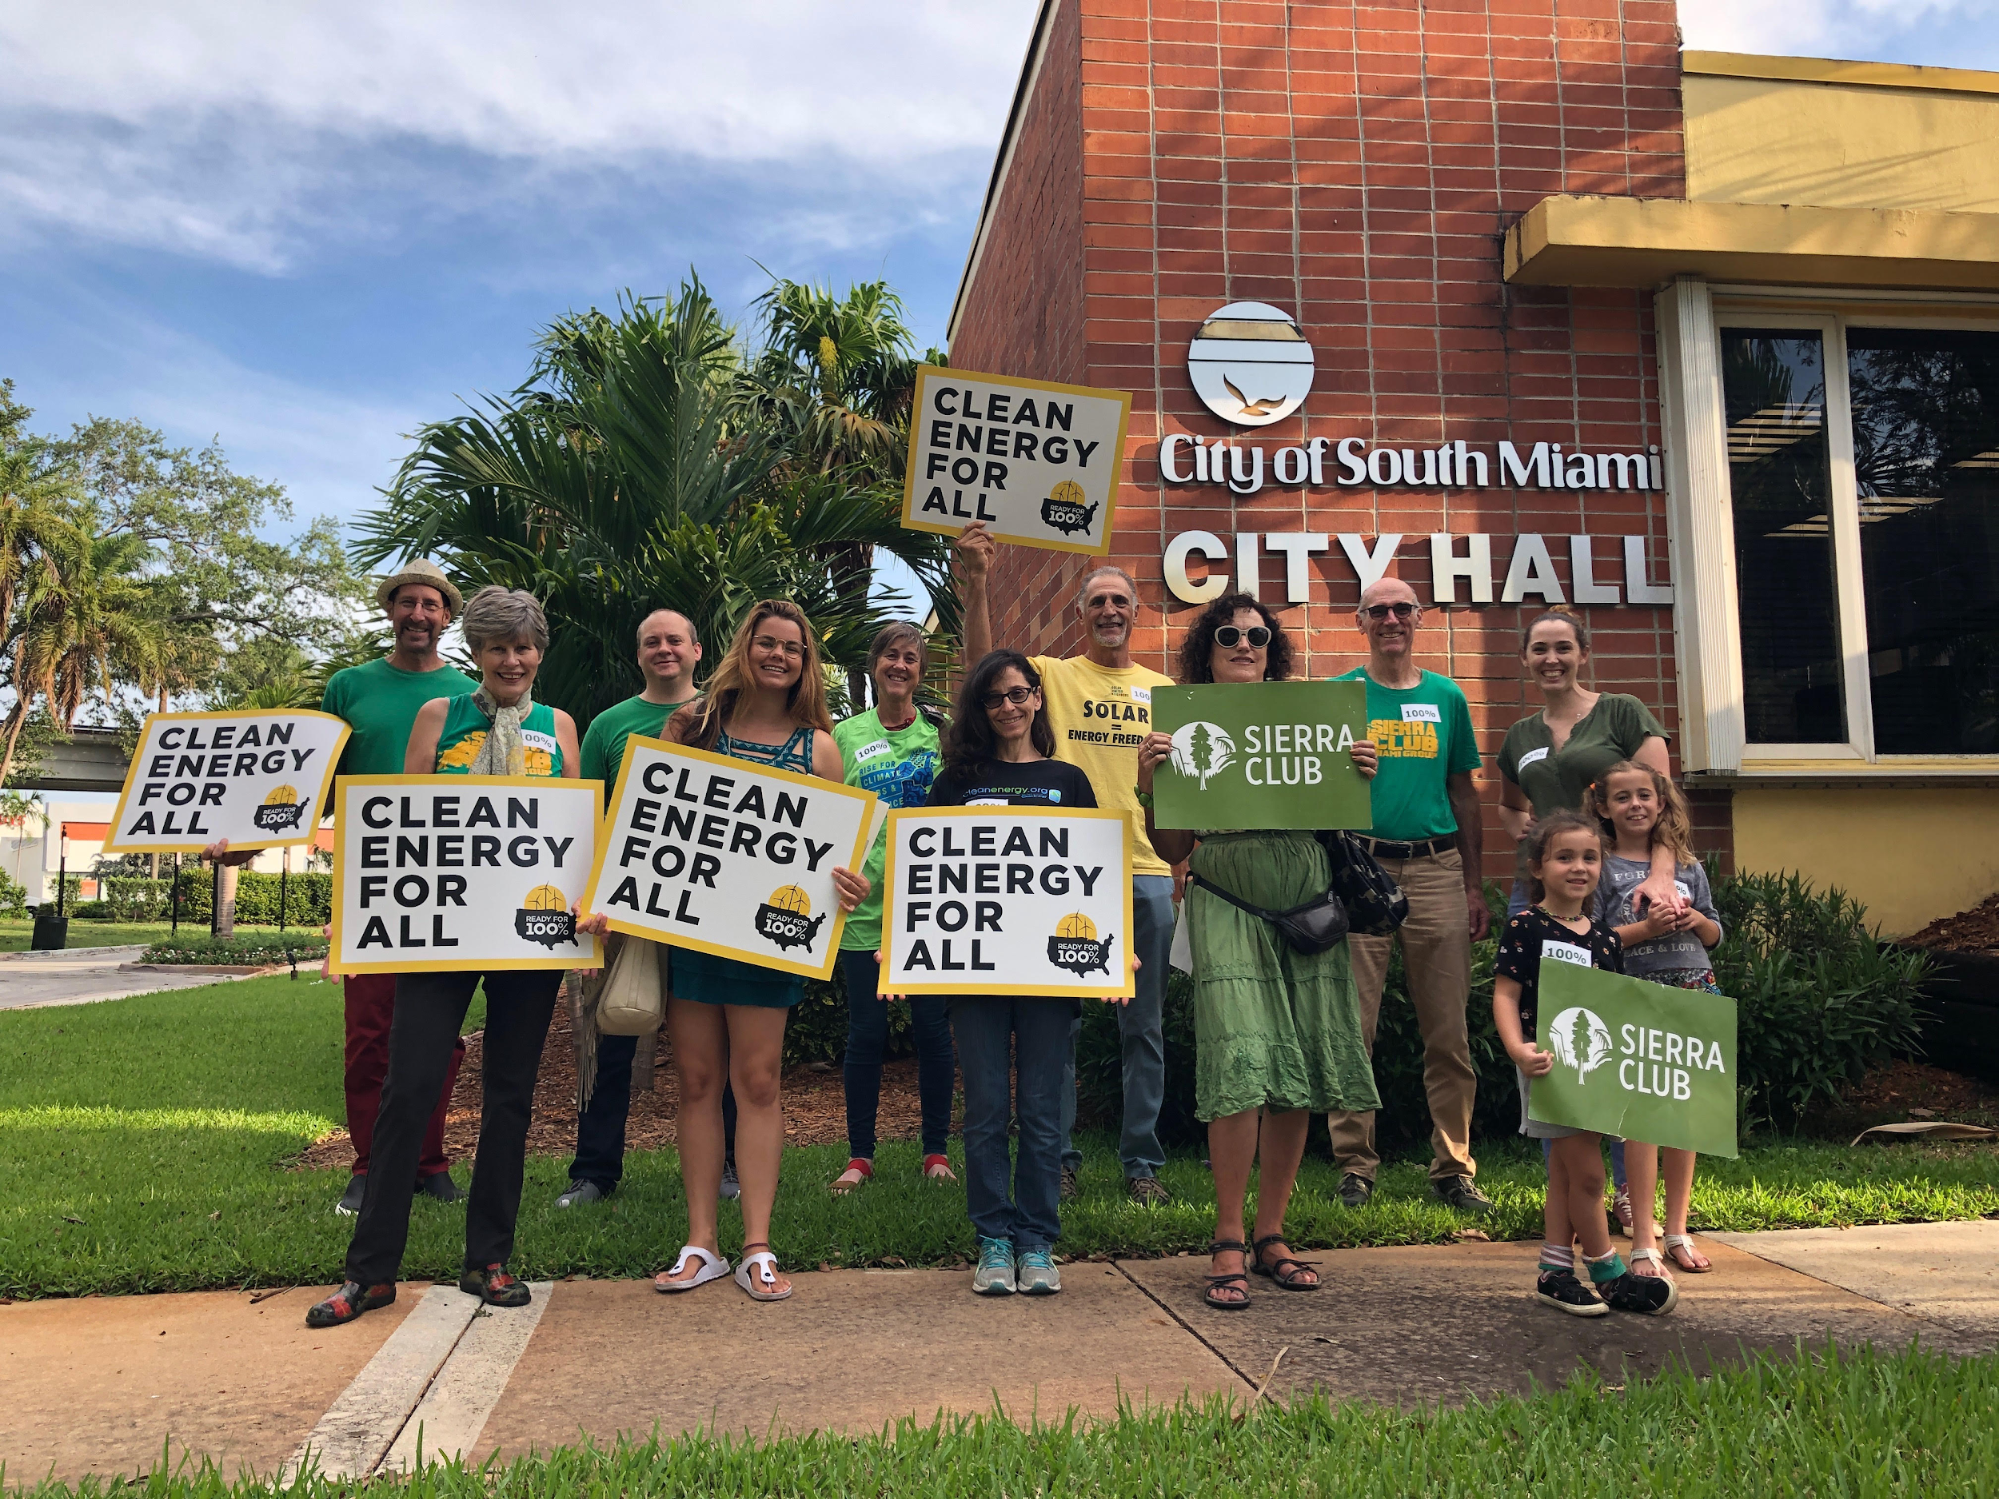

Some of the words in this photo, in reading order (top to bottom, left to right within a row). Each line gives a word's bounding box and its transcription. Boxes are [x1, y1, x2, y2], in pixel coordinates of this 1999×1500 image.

[934, 387, 1074, 432] CLEAN
[930, 419, 1100, 468] ENERGY
[926, 452, 1009, 491] FOR
[1160, 433, 1264, 494] City
[1273, 436, 1331, 486] of
[1337, 437, 1489, 487] South
[1498, 440, 1663, 490] Miami
[921, 486, 997, 522] ALL
[1048, 510, 1085, 525] 100%
[1050, 504, 1071, 512] READY
[1071, 507, 1085, 515] FOR
[1163, 530, 1403, 604] CITY
[1430, 533, 1675, 604] HALL
[1134, 690, 1151, 701] 100
[1083, 700, 1149, 724] SOLAR
[1405, 709, 1436, 718] 100%
[158, 723, 295, 750] CLEAN
[522, 733, 552, 748] 00%
[1068, 729, 1110, 743] ENERGY
[1112, 733, 1145, 745] FREED
[1244, 723, 1354, 754] SIERRA
[1370, 719, 1437, 737] SIERRA
[858, 742, 888, 758] 100%
[1374, 733, 1438, 752] CLUB
[1377, 749, 1402, 758] IAMI
[1402, 750, 1438, 759] GROUP
[148, 748, 316, 778] ENERGY
[859, 763, 877, 776] RISE
[880, 760, 896, 769] FOR
[1245, 756, 1323, 786] CLUB
[138, 782, 227, 806] FOR
[642, 762, 809, 829] CLEAN
[962, 787, 1048, 798] cleanenergy.org
[127, 811, 209, 836] ALL
[260, 812, 295, 824] 100%
[361, 796, 539, 829] CLEAN
[630, 797, 834, 873] ENERGY
[909, 826, 1069, 858] CLEAN
[361, 835, 575, 868] ENERGY
[619, 835, 722, 889] FOR
[360, 874, 468, 908] FOR
[907, 863, 1104, 896] ENERGY
[606, 875, 701, 926] ALL
[525, 915, 552, 923] READY
[552, 915, 569, 923] FOR
[525, 922, 569, 936] 100%
[763, 919, 808, 940] 100%
[766, 912, 792, 923] READY
[793, 918, 809, 928] FOR
[906, 900, 1004, 932] FOR
[356, 914, 459, 949] ALL
[902, 939, 996, 971] ALL
[1057, 950, 1100, 964] 100%
[1547, 947, 1587, 965] 100%
[1623, 945, 1654, 958] EACE
[1671, 942, 1697, 953] LOVE
[1620, 1023, 1726, 1074] SIERRA
[1619, 1058, 1691, 1101] CLUB
